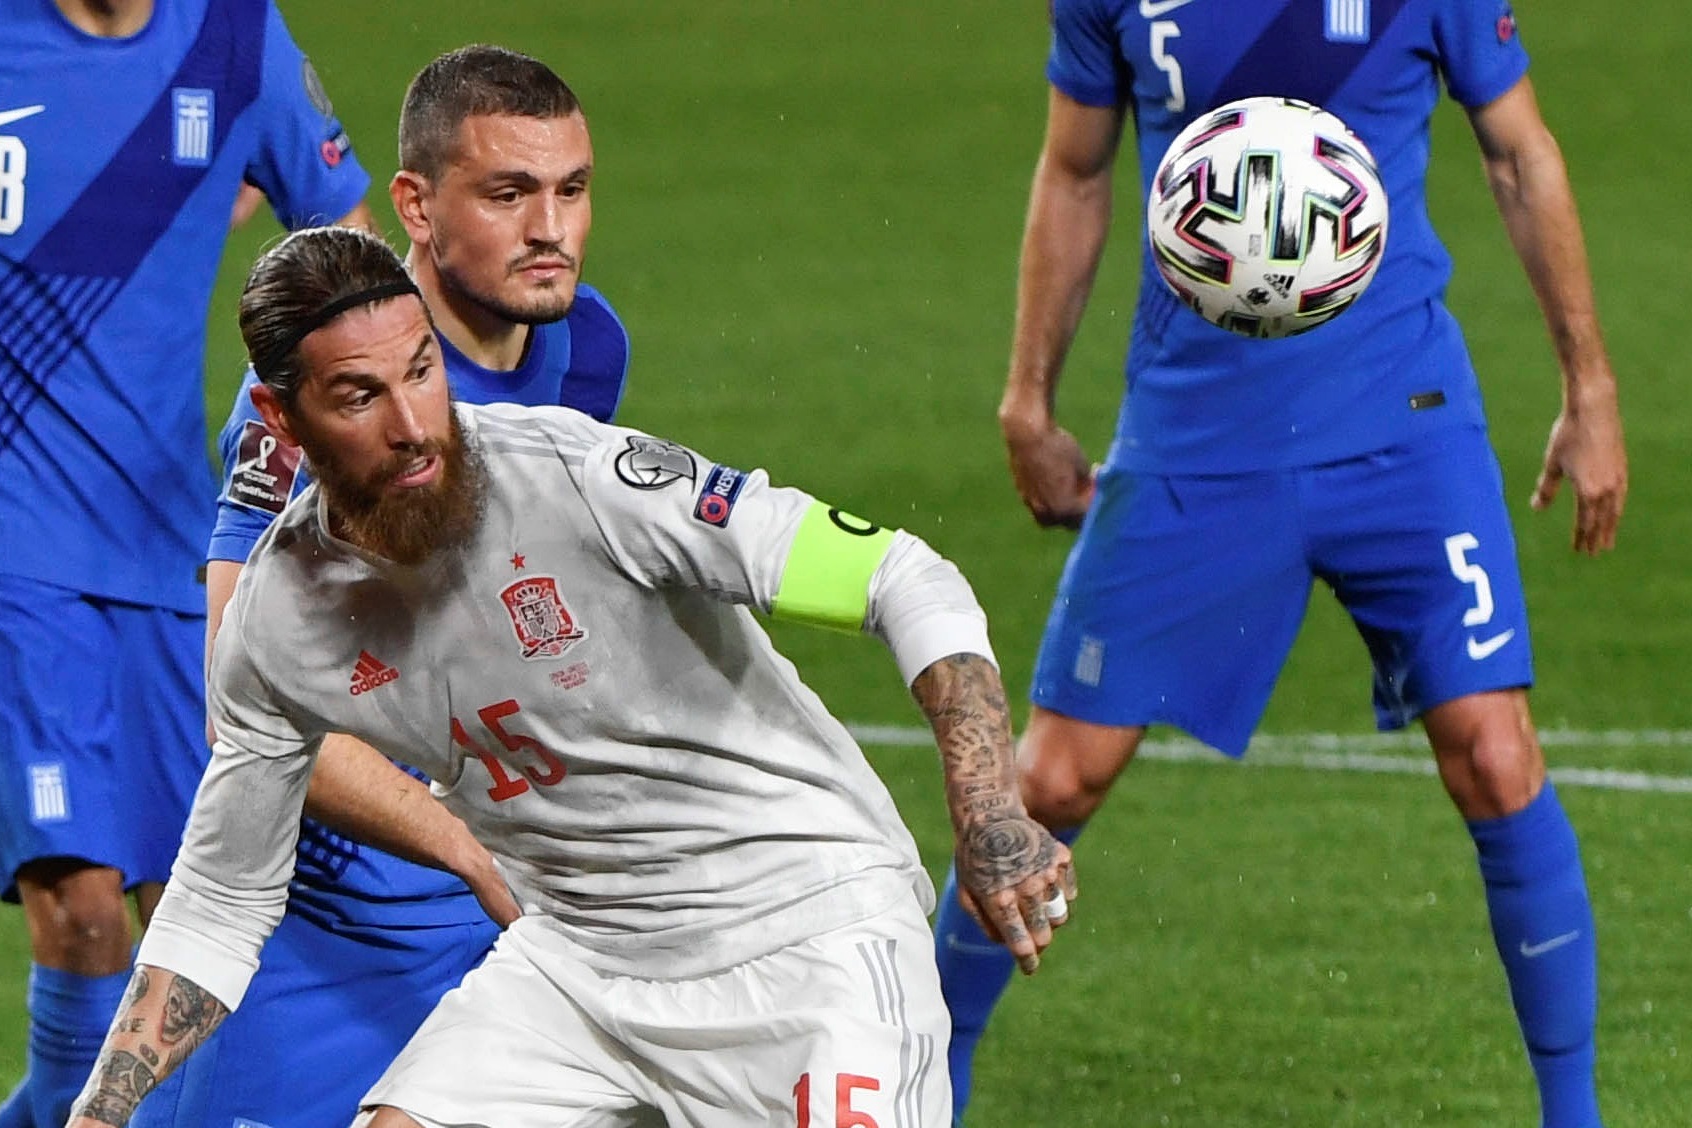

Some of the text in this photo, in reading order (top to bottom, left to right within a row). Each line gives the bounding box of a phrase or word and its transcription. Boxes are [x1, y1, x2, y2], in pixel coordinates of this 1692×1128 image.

[1149, 20, 1185, 111] 5
[1445, 532, 1494, 627] 5
[350, 667, 400, 696] adidas
[451, 699, 567, 802] 15
